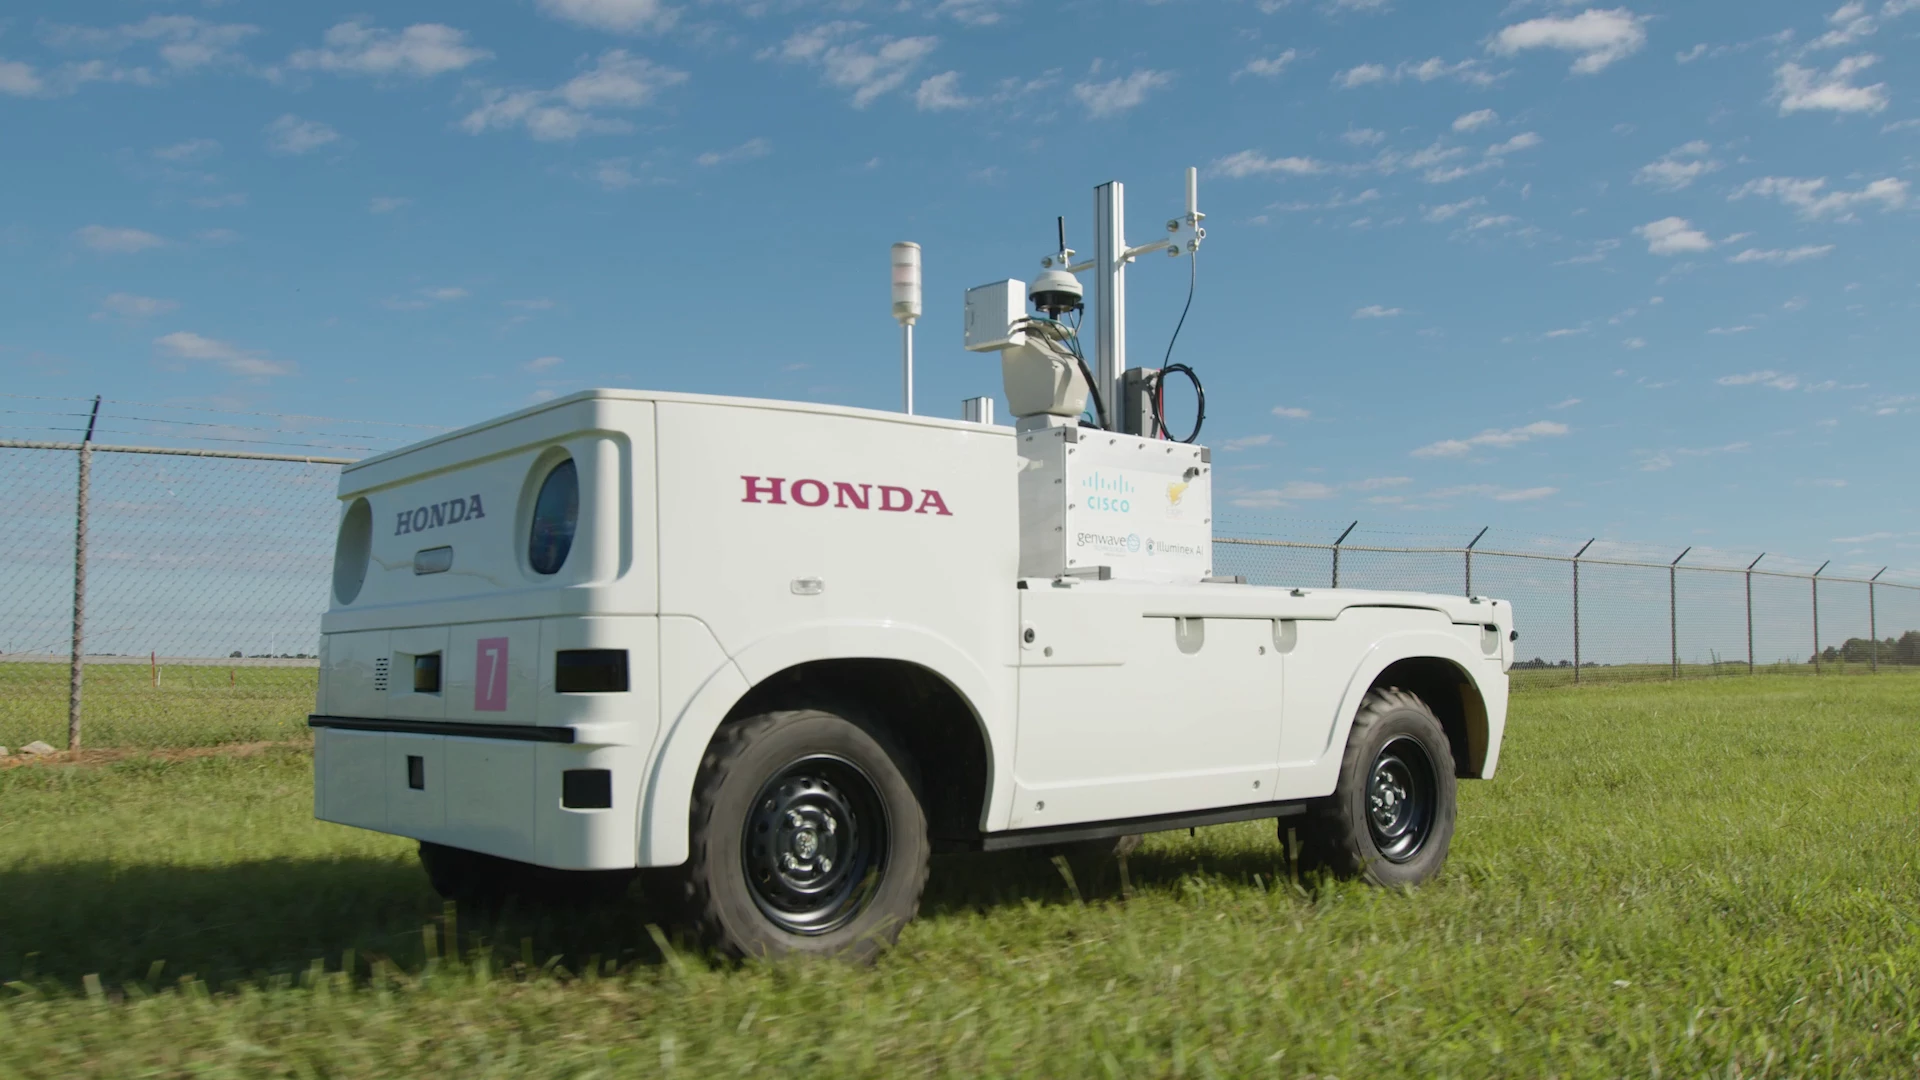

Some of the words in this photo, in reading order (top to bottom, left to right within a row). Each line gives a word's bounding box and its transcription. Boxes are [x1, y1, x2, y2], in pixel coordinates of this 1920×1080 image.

[740, 475, 953, 516] HONDA
[1087, 495, 1130, 513] CISCO
[394, 494, 485, 536] HONDA
[1076, 532, 1127, 547] genwave
[1156, 541, 1194, 555] Illuminex
[1196, 545, 1204, 556] AI
[485, 648, 499, 701] 7
